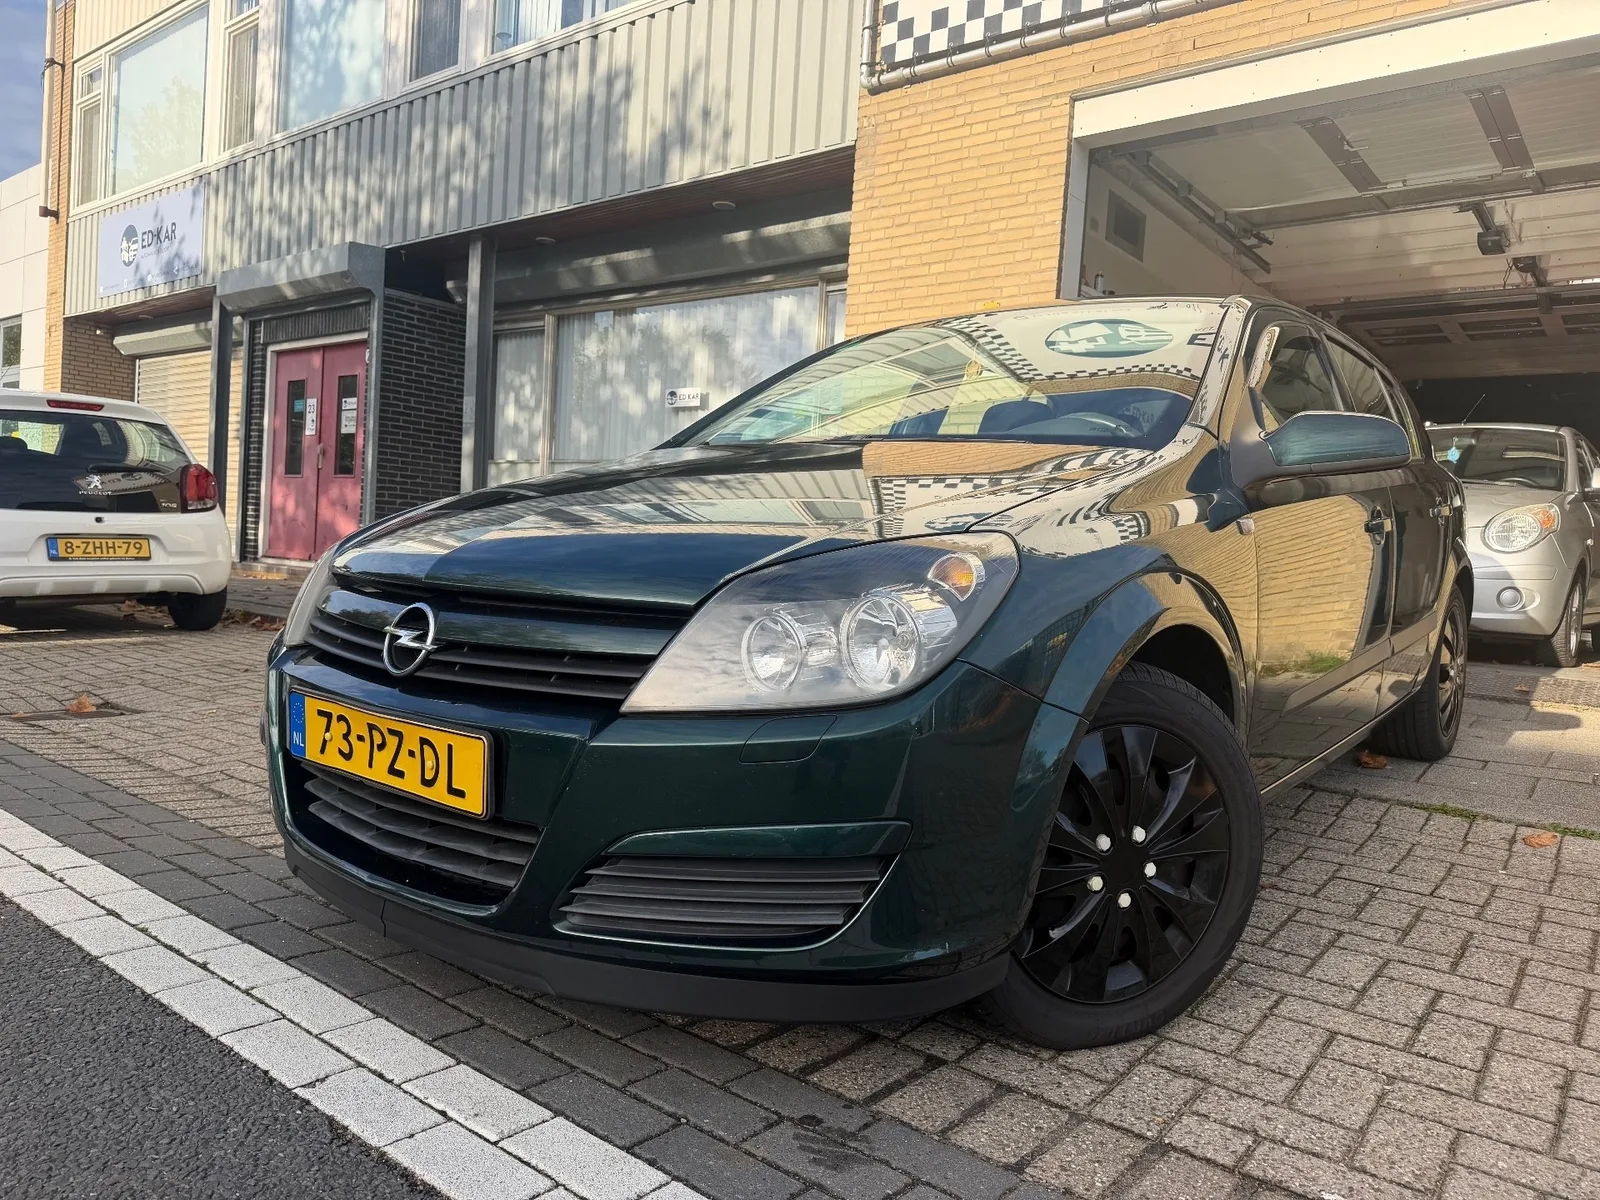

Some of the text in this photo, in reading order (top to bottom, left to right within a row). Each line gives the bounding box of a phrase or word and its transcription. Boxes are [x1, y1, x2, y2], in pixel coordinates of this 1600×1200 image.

[141, 222, 177, 249] ED-KAR
[308, 404, 316, 414] 23
[64, 541, 143, 555] 8-ZHH-79
[293, 708, 467, 799] NL 73-PZ-DL
